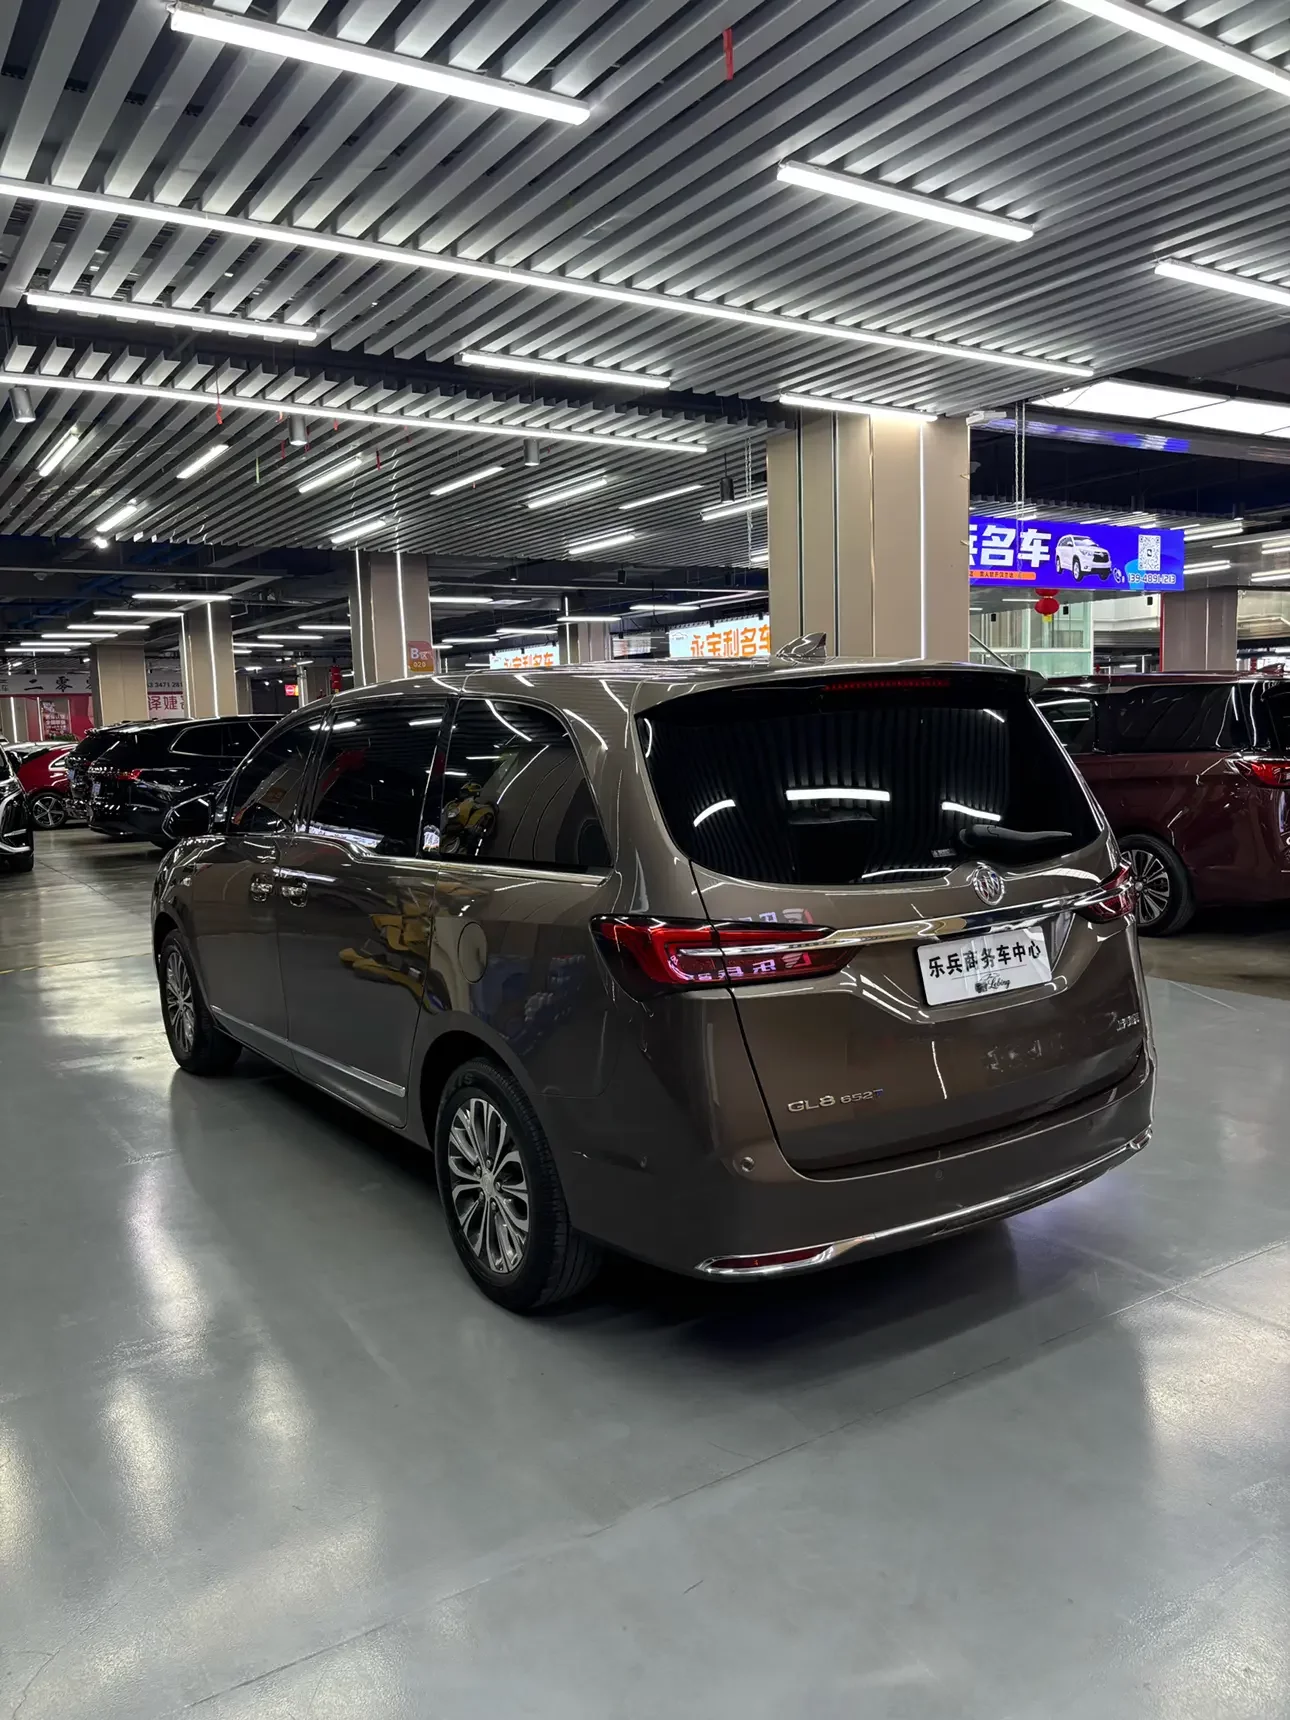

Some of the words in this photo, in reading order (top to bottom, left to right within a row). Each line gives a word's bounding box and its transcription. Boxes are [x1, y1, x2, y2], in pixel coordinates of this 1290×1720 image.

[928, 940, 1042, 978] 乐兵商务车中心
[787, 1095, 836, 1112] GL8
[840, 1088, 884, 1104] 652T
